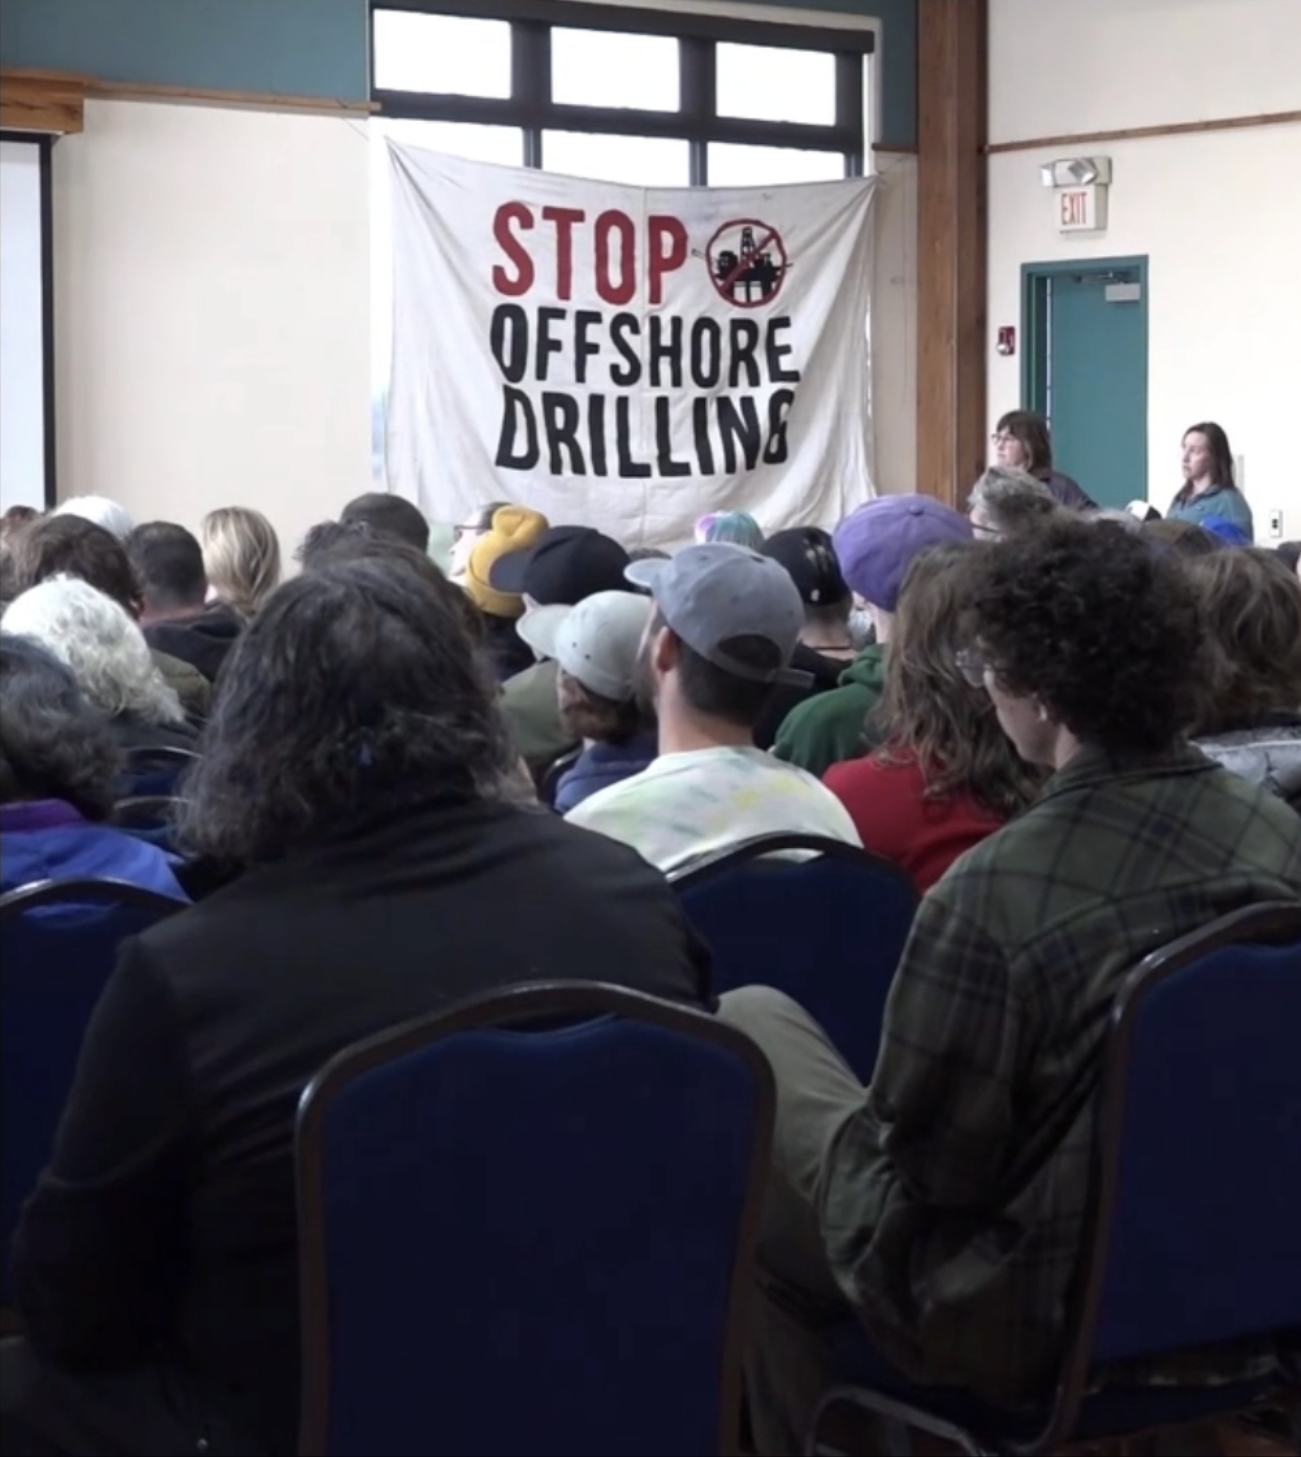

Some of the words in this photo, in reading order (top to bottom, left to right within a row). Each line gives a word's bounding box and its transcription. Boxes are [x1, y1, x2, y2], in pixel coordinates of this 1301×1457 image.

[1061, 191, 1087, 225] EXIT
[492, 201, 688, 305] STOP
[490, 303, 801, 388] OFFSHORE
[495, 384, 796, 478] DRILLING
